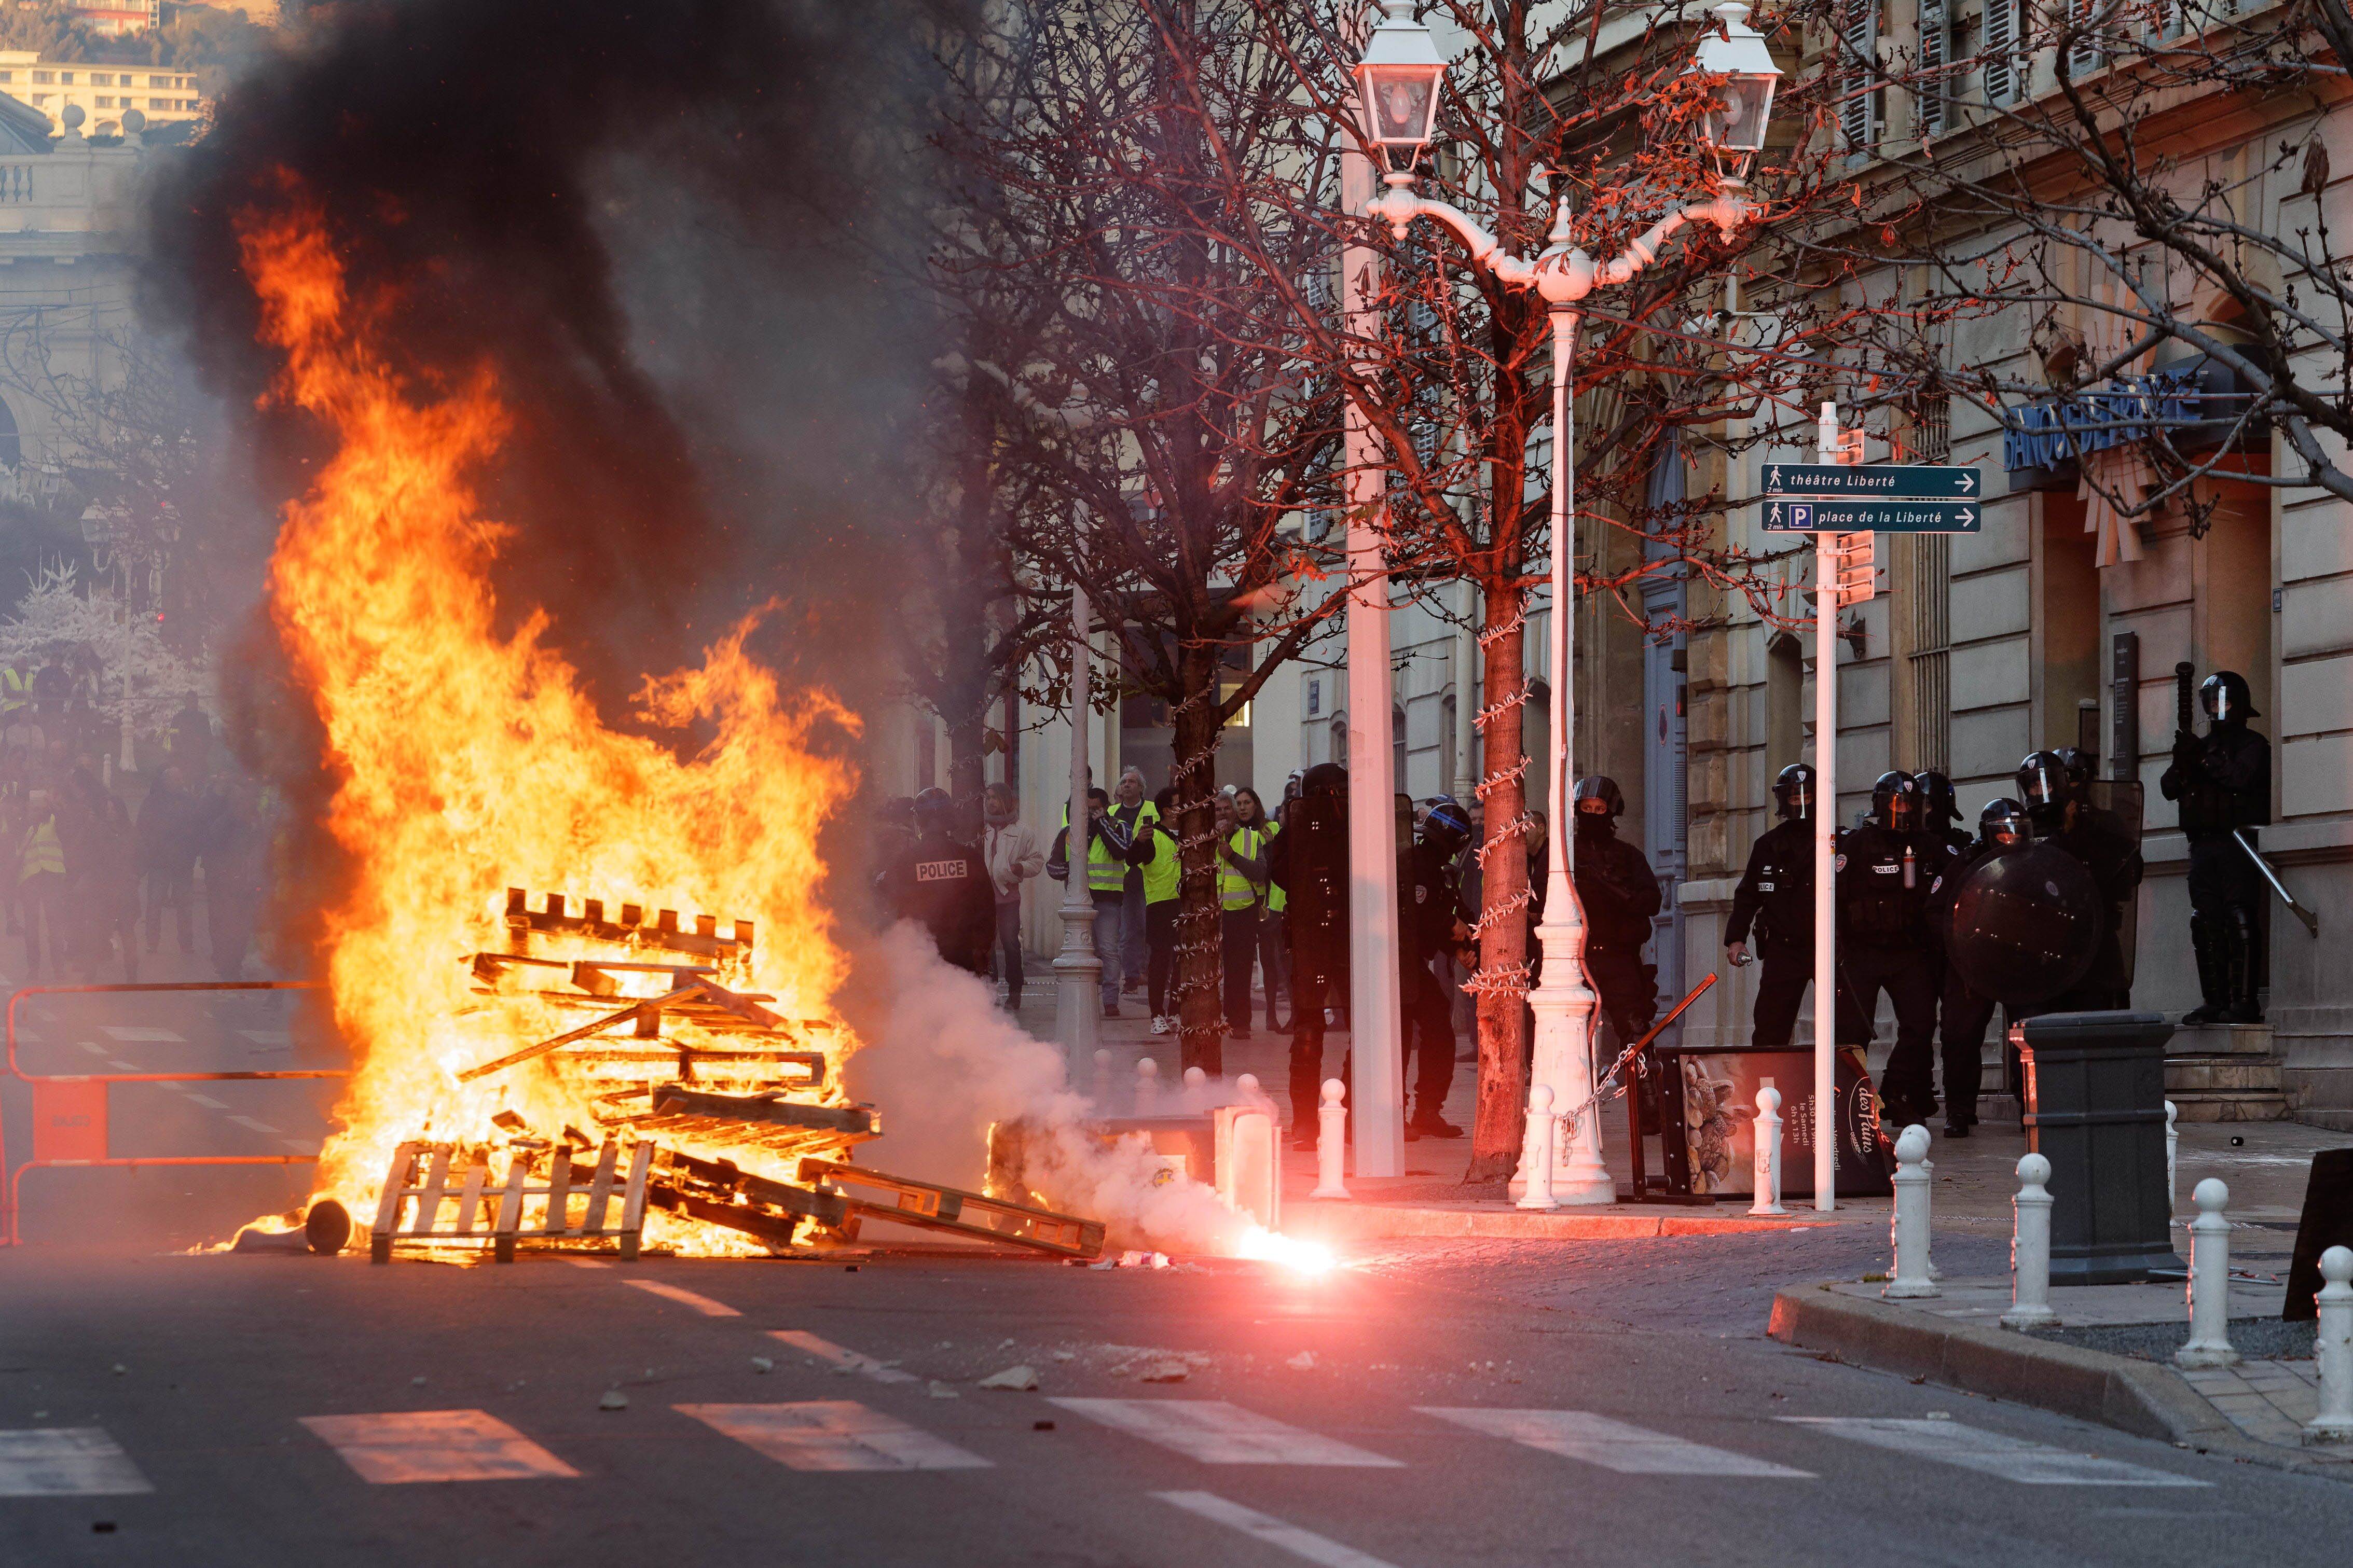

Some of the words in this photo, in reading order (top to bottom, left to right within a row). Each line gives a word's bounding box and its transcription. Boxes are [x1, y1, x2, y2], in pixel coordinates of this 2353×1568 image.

[1791, 474, 1841, 485] théâtre
[1847, 475, 1895, 487] Liberté
[1795, 508, 1807, 525] P
[1818, 511, 1853, 525] place
[1859, 511, 1874, 522] de
[1879, 511, 1890, 522] la
[1896, 511, 1942, 523] Liberté
[919, 862, 965, 879] POLICE
[1799, 1103, 1806, 1111] le
[1859, 1087, 1874, 1111] des
[1791, 1106, 1797, 1117] 6h
[1800, 1113, 1809, 1146] Samedi
[1858, 1113, 1879, 1153] Pains
